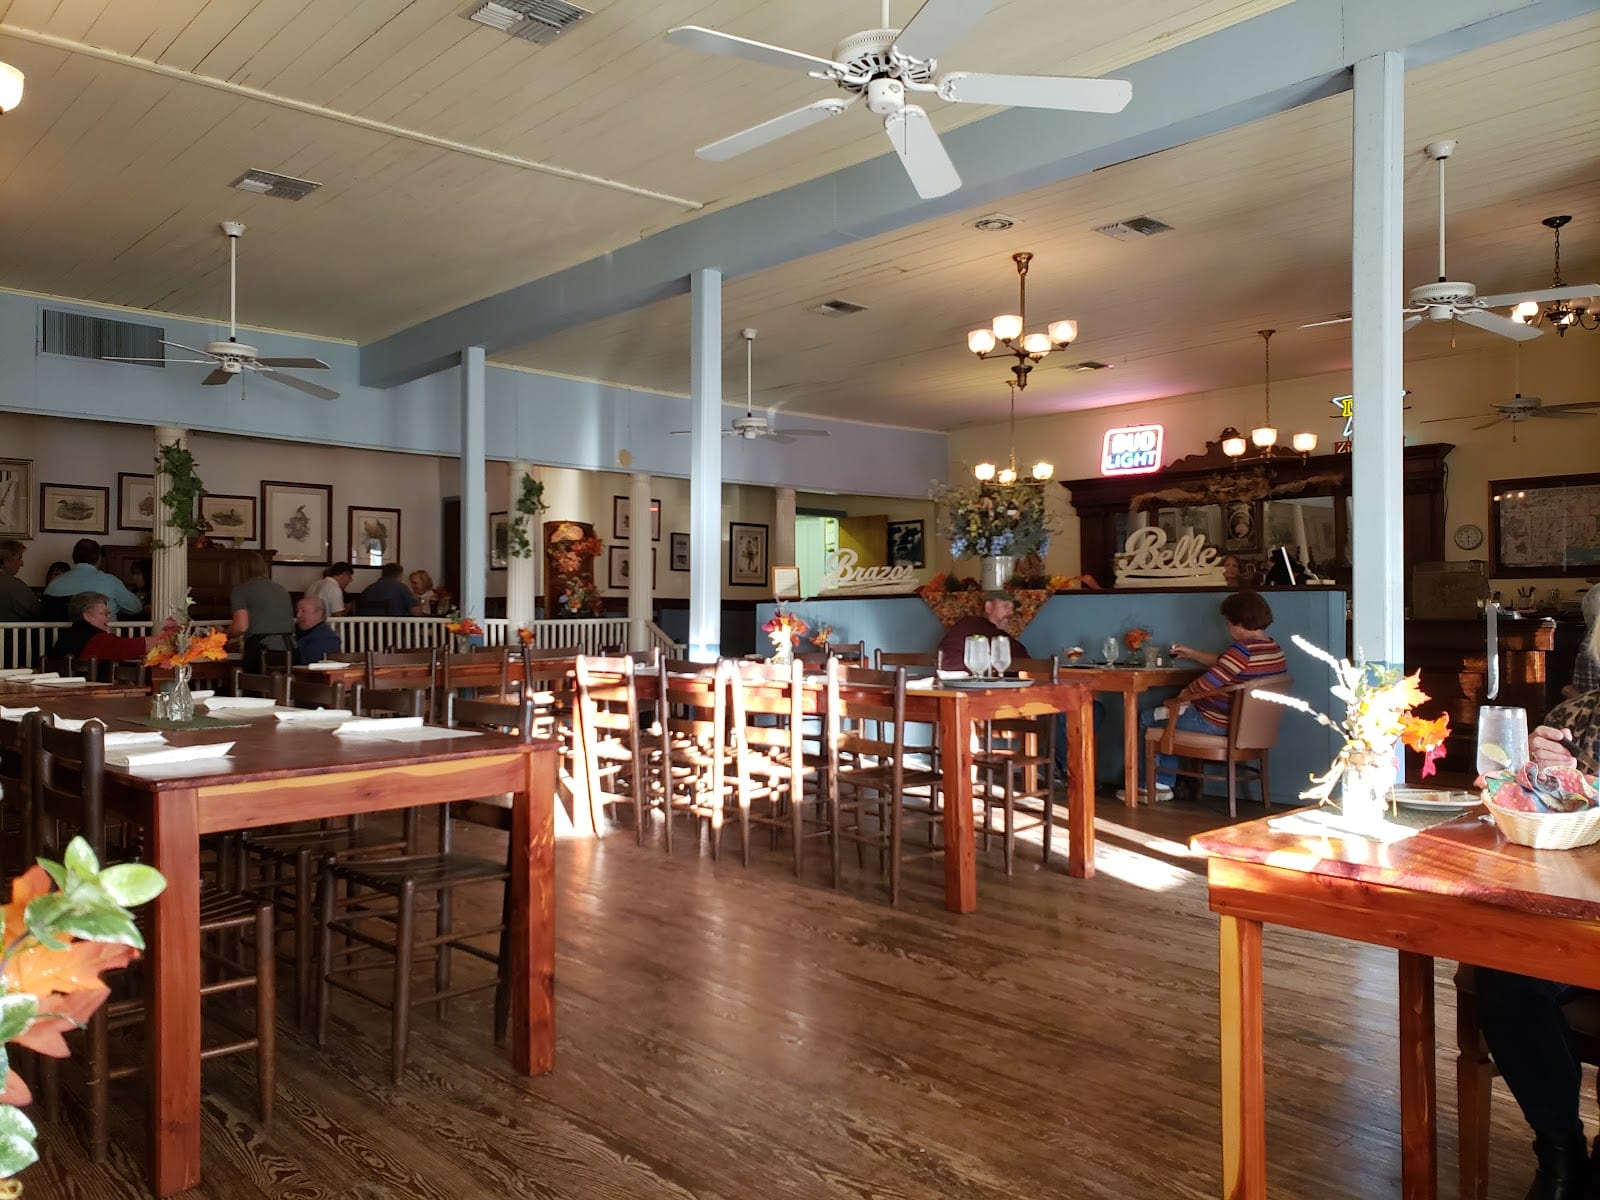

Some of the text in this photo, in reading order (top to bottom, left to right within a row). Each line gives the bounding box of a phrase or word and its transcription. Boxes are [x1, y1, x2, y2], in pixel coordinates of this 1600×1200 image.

[1111, 430, 1157, 454] BUD
[1106, 450, 1157, 469] LIGHT
[1114, 526, 1223, 569] Belle
[824, 548, 915, 583] Brazos
